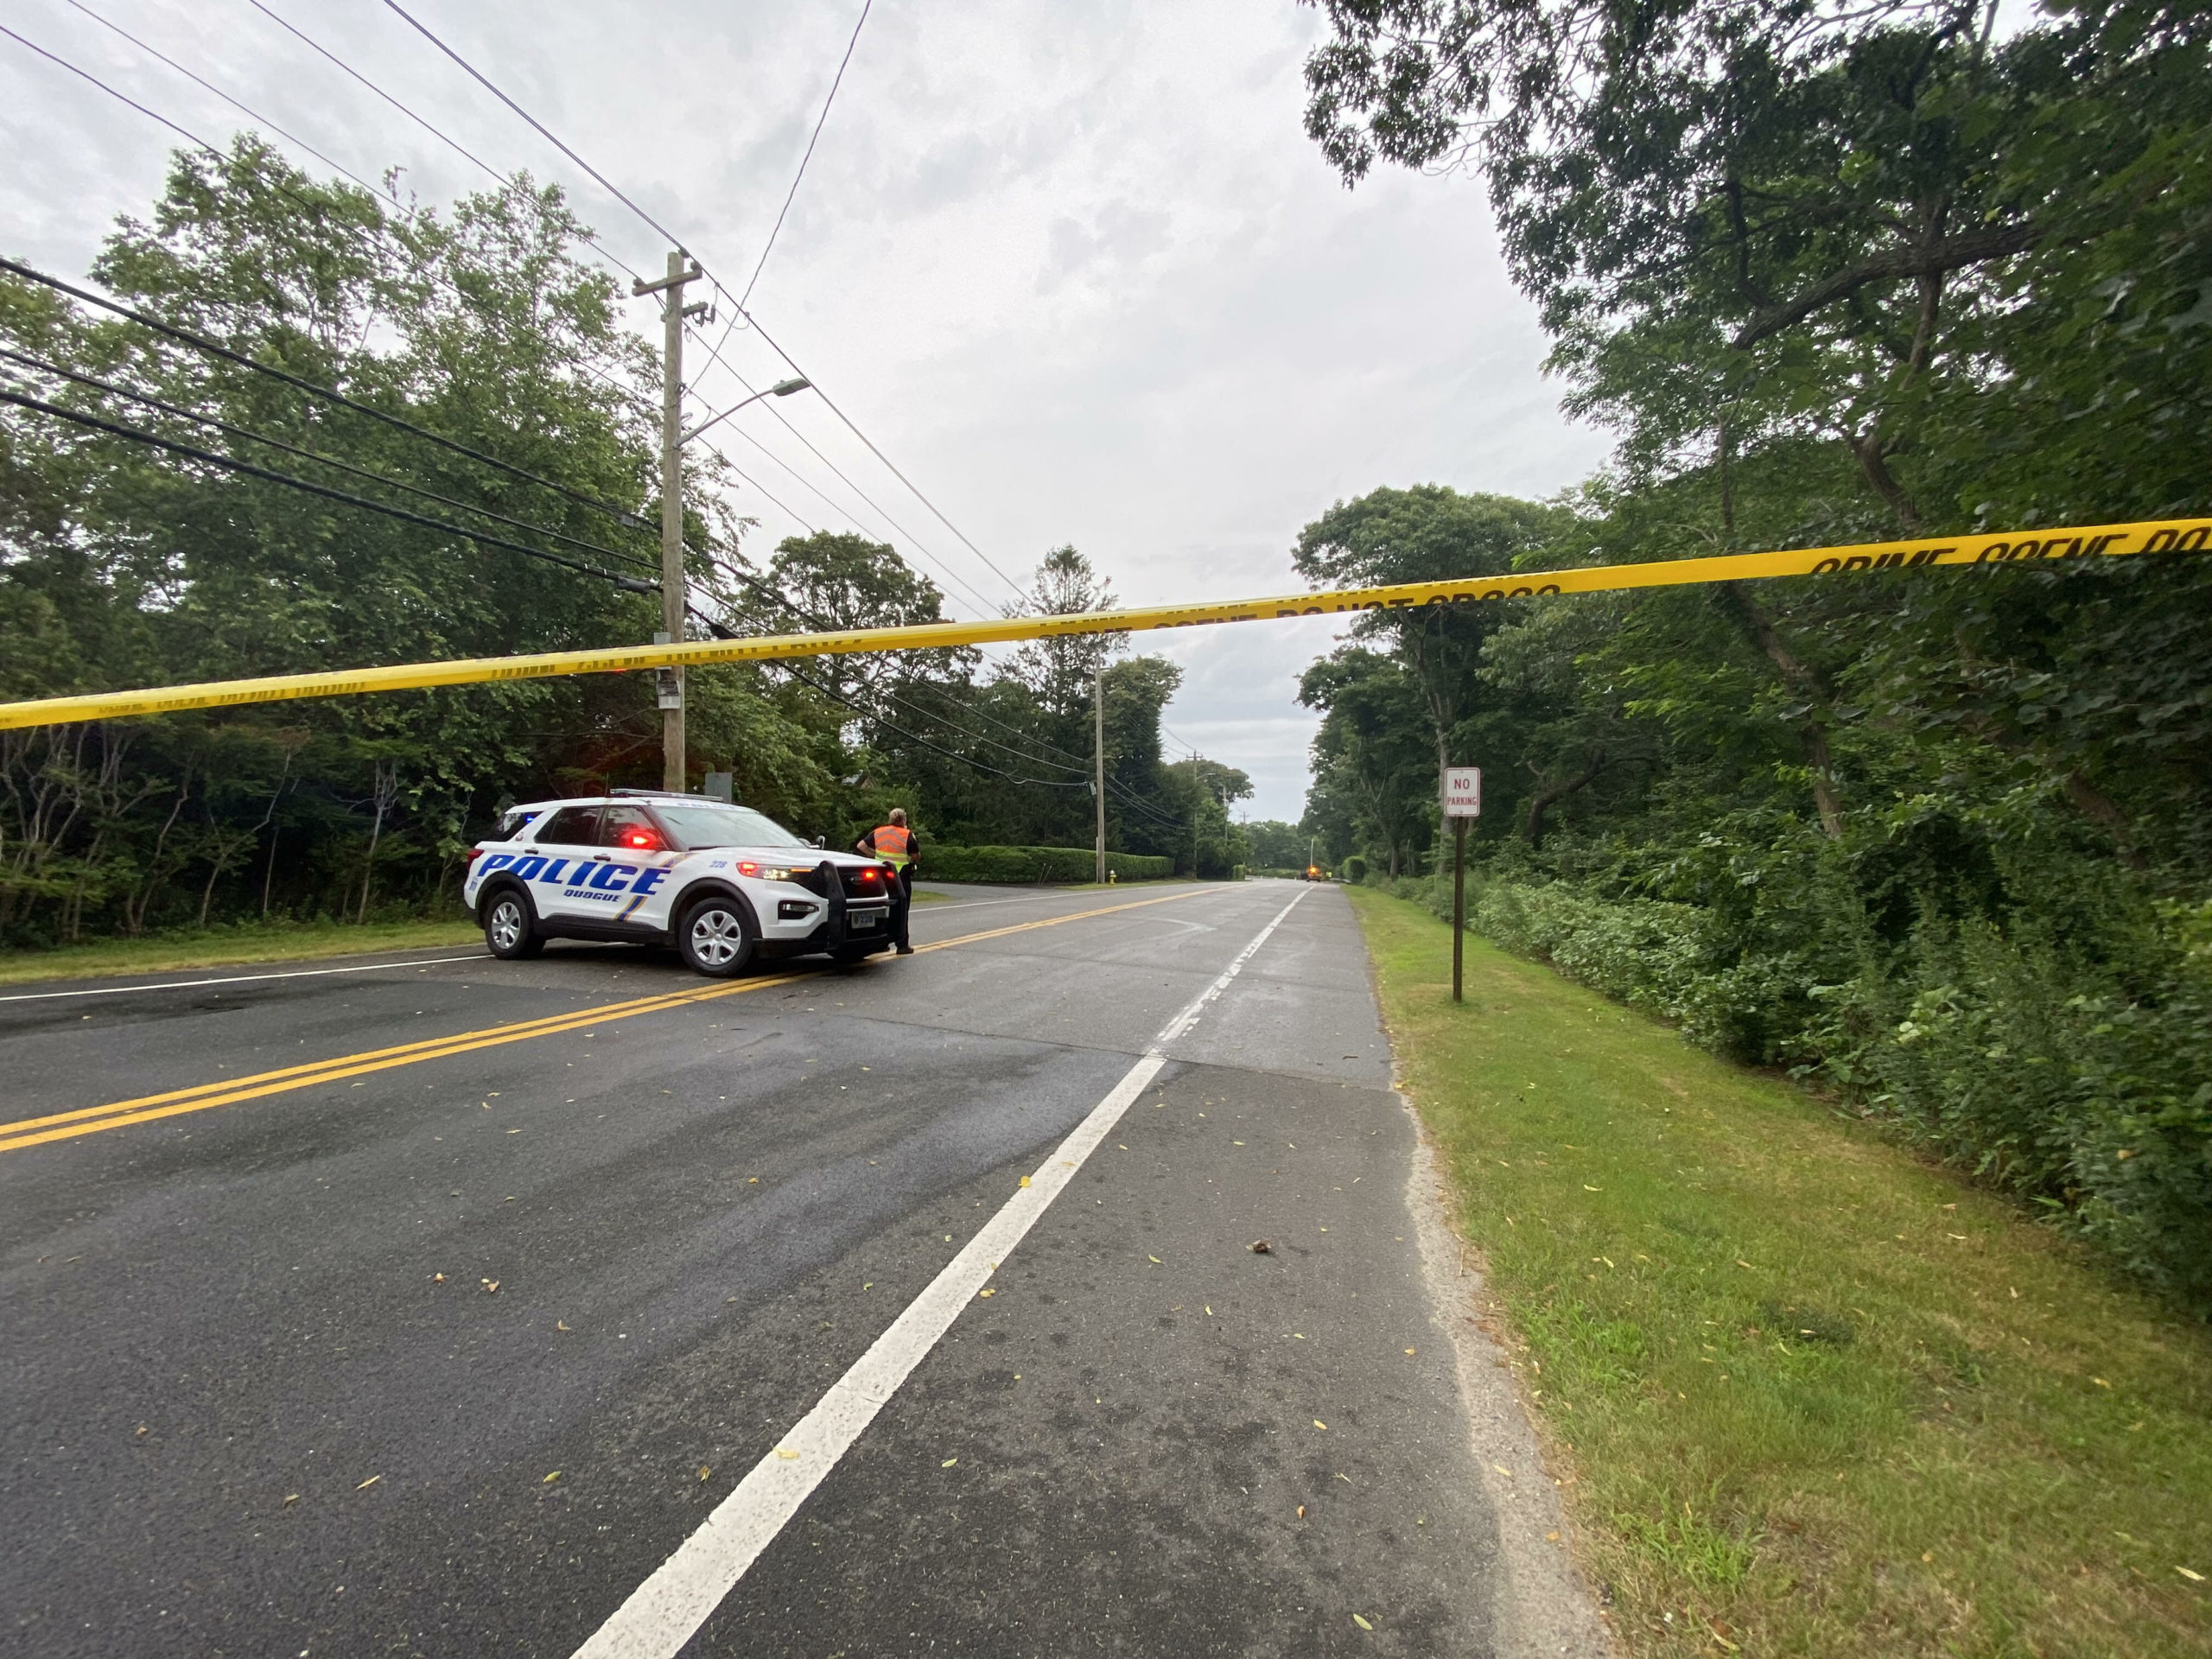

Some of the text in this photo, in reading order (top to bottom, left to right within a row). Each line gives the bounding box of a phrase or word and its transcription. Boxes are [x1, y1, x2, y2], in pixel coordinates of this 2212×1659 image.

[1454, 779, 1470, 790] NO
[1447, 797, 1478, 805] PARKING
[477, 855, 671, 895] POLICE
[563, 888, 622, 903] QUOGUE
